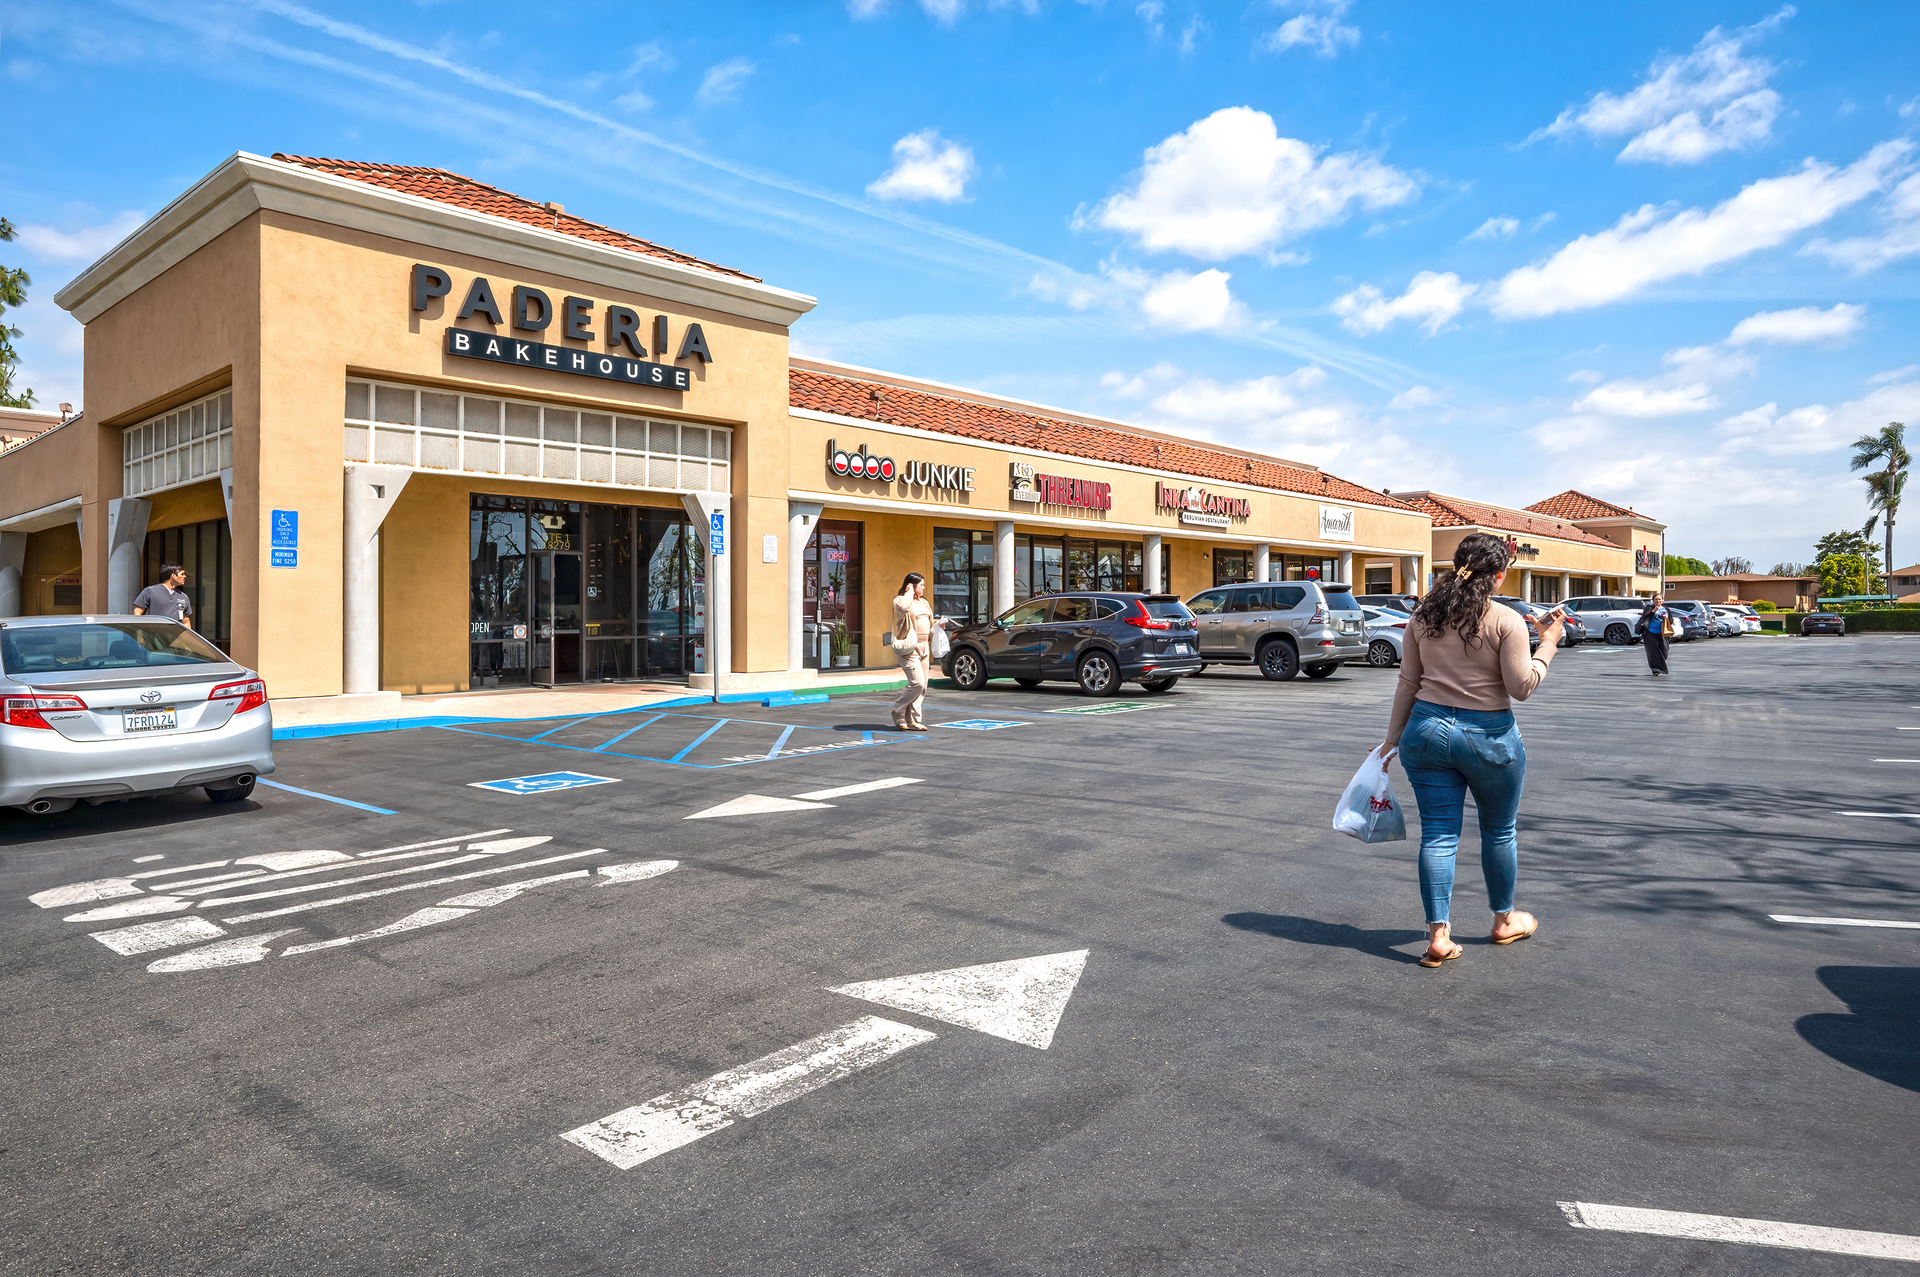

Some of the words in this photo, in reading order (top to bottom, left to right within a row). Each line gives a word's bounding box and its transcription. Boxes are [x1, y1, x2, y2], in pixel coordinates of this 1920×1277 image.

[411, 263, 713, 364] PADERIA
[455, 332, 687, 387] BAKEHOUSE
[828, 438, 896, 482] boba
[902, 460, 977, 492] JUNKIE
[1038, 474, 1112, 511] THREADING
[1157, 481, 1191, 510] INKA
[1200, 488, 1252, 517] CANTINA
[1184, 513, 1205, 523] PERUVIAN
[1205, 516, 1231, 526] RESTAURANT
[828, 552, 848, 562] OPEN
[470, 622, 490, 633] OPEN
[722, 754, 772, 762] NO
